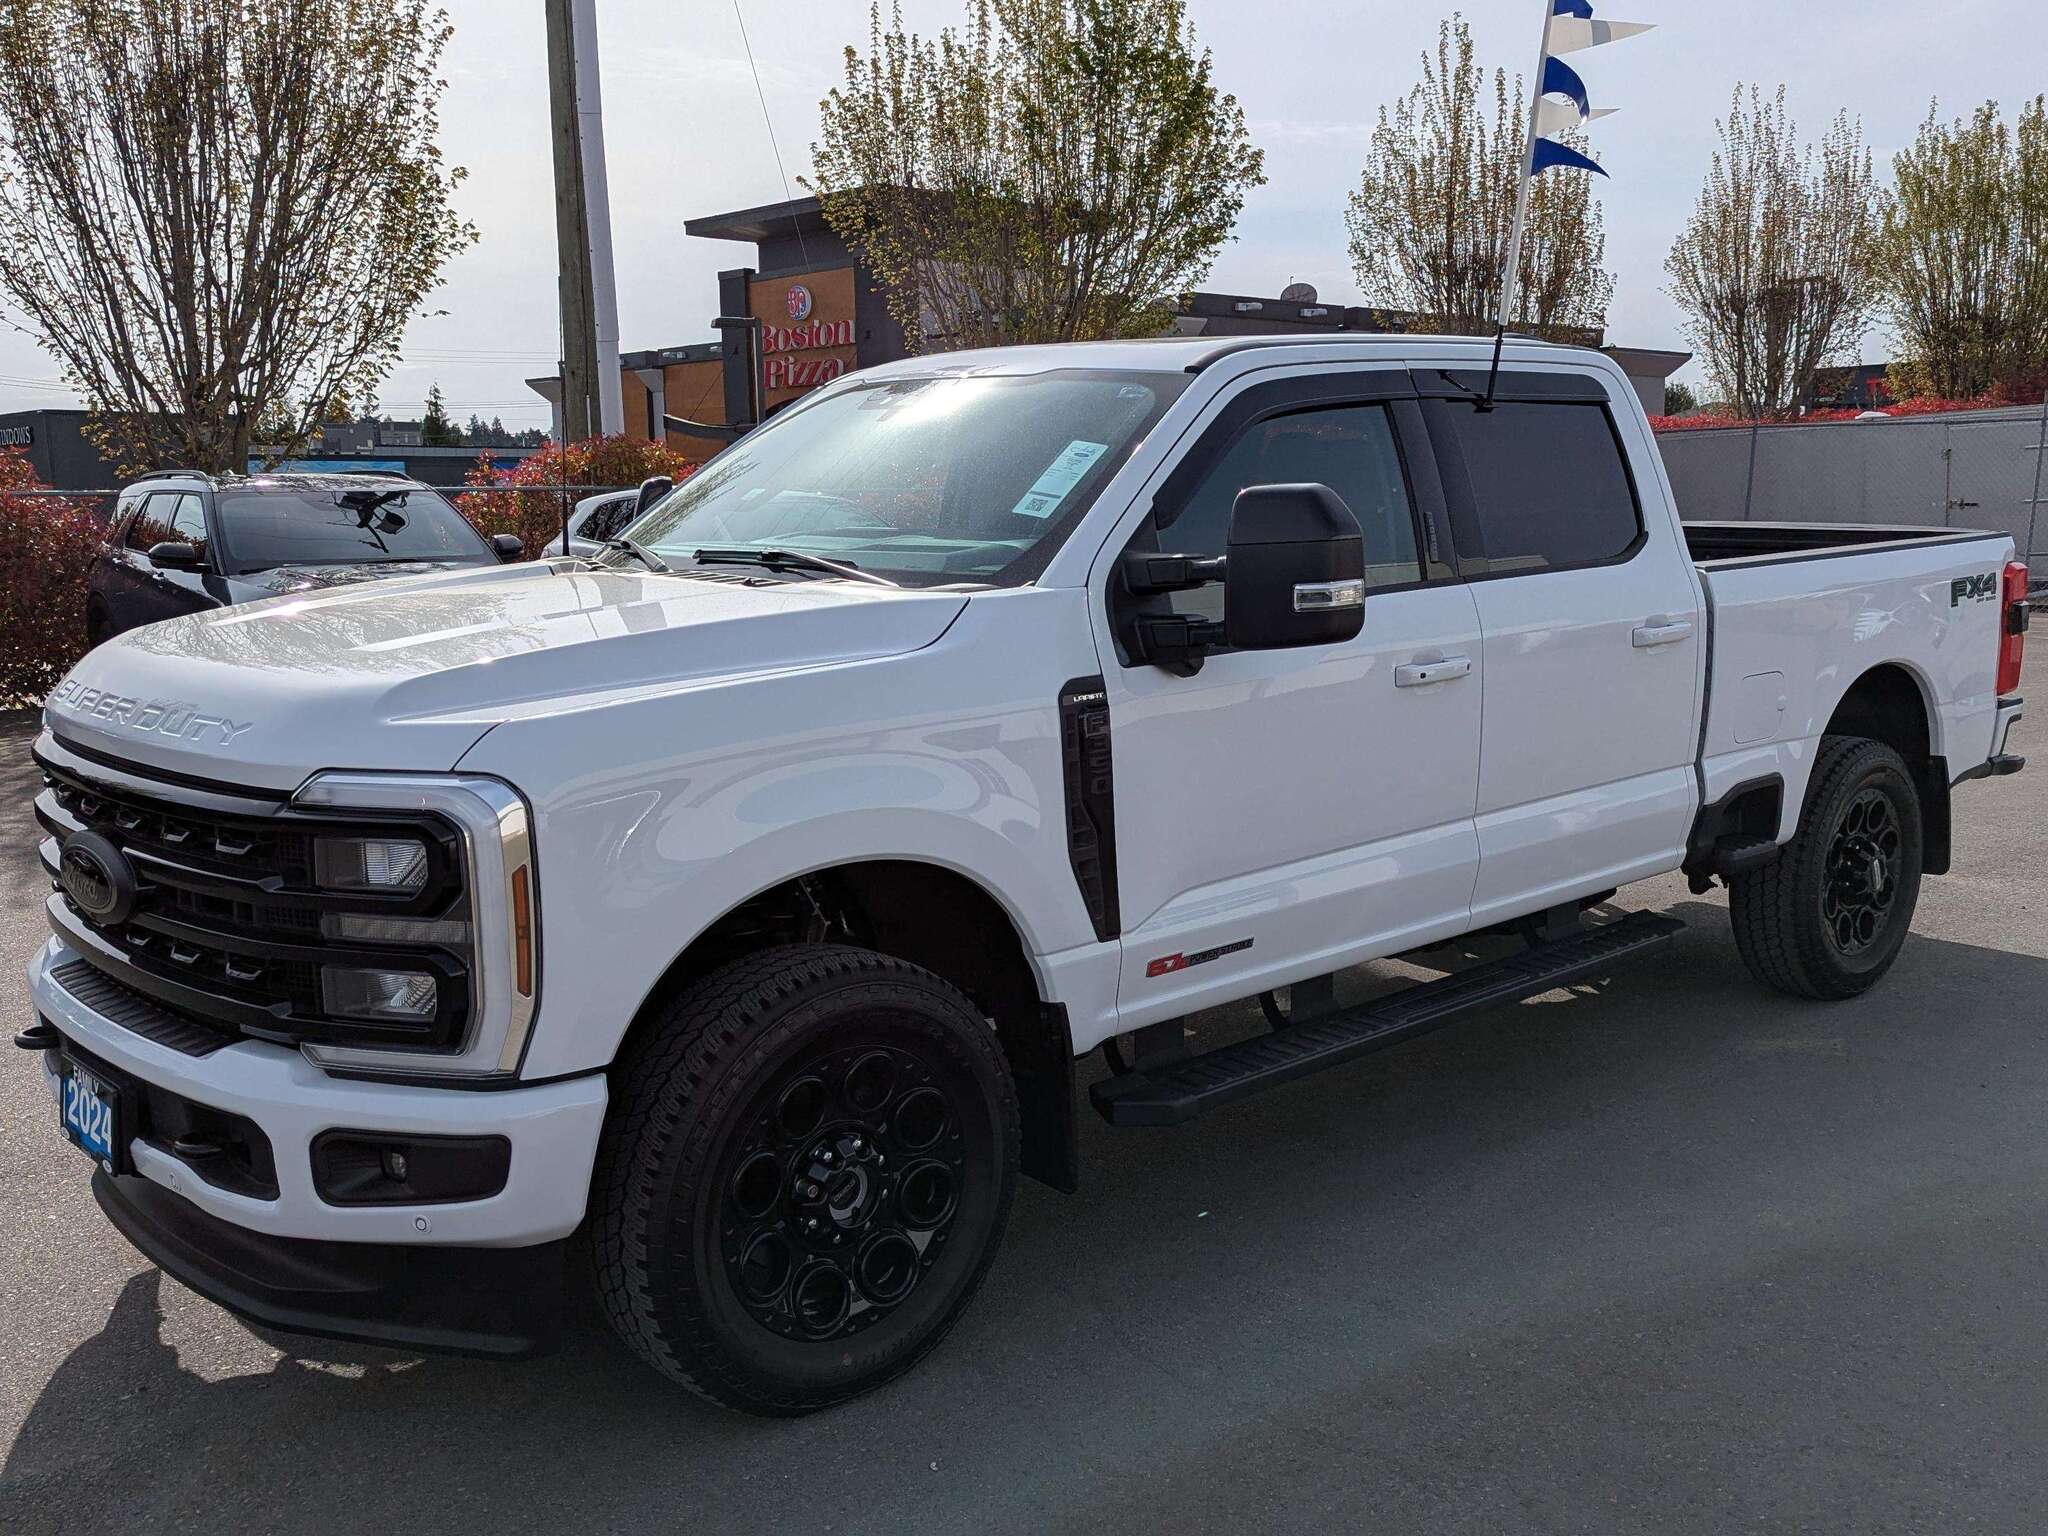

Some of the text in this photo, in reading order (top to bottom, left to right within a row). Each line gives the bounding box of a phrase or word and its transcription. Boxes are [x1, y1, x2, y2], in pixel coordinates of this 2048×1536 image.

[762, 319, 857, 354] Boston
[763, 356, 844, 389] Pizza
[0, 425, 31, 445] INDOWS
[1950, 571, 1997, 608] FX4
[54, 679, 254, 746] SUPER DUTY
[68, 1078, 112, 1154] 2024
